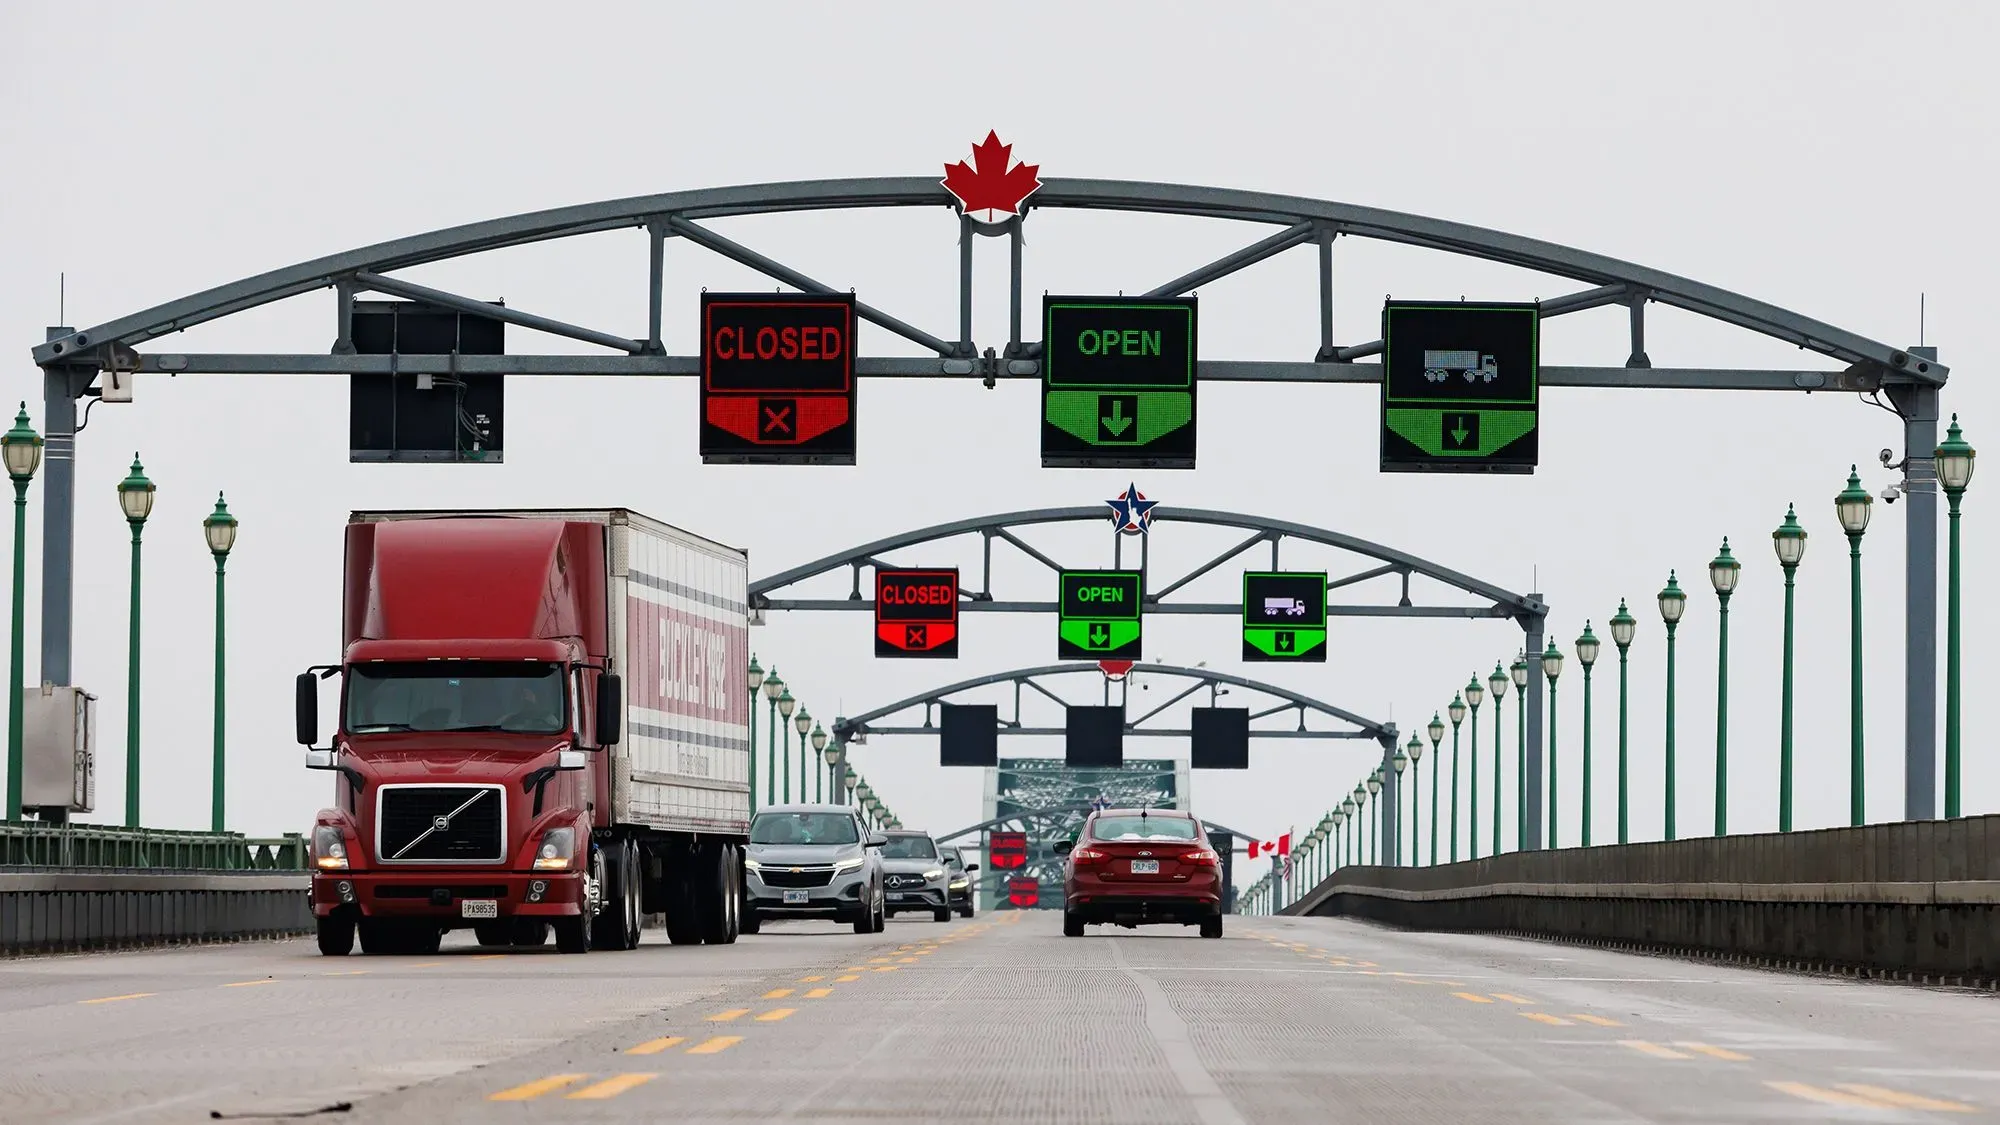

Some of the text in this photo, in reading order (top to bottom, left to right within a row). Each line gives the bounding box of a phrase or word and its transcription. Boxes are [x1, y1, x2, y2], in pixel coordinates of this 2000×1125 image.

[715, 327, 841, 360] CLOSED
[1079, 330, 1161, 355] OPEN
[881, 585, 952, 605] CLOSED
[1078, 587, 1123, 602] OPEN
[660, 617, 707, 705] BUCKLEY
